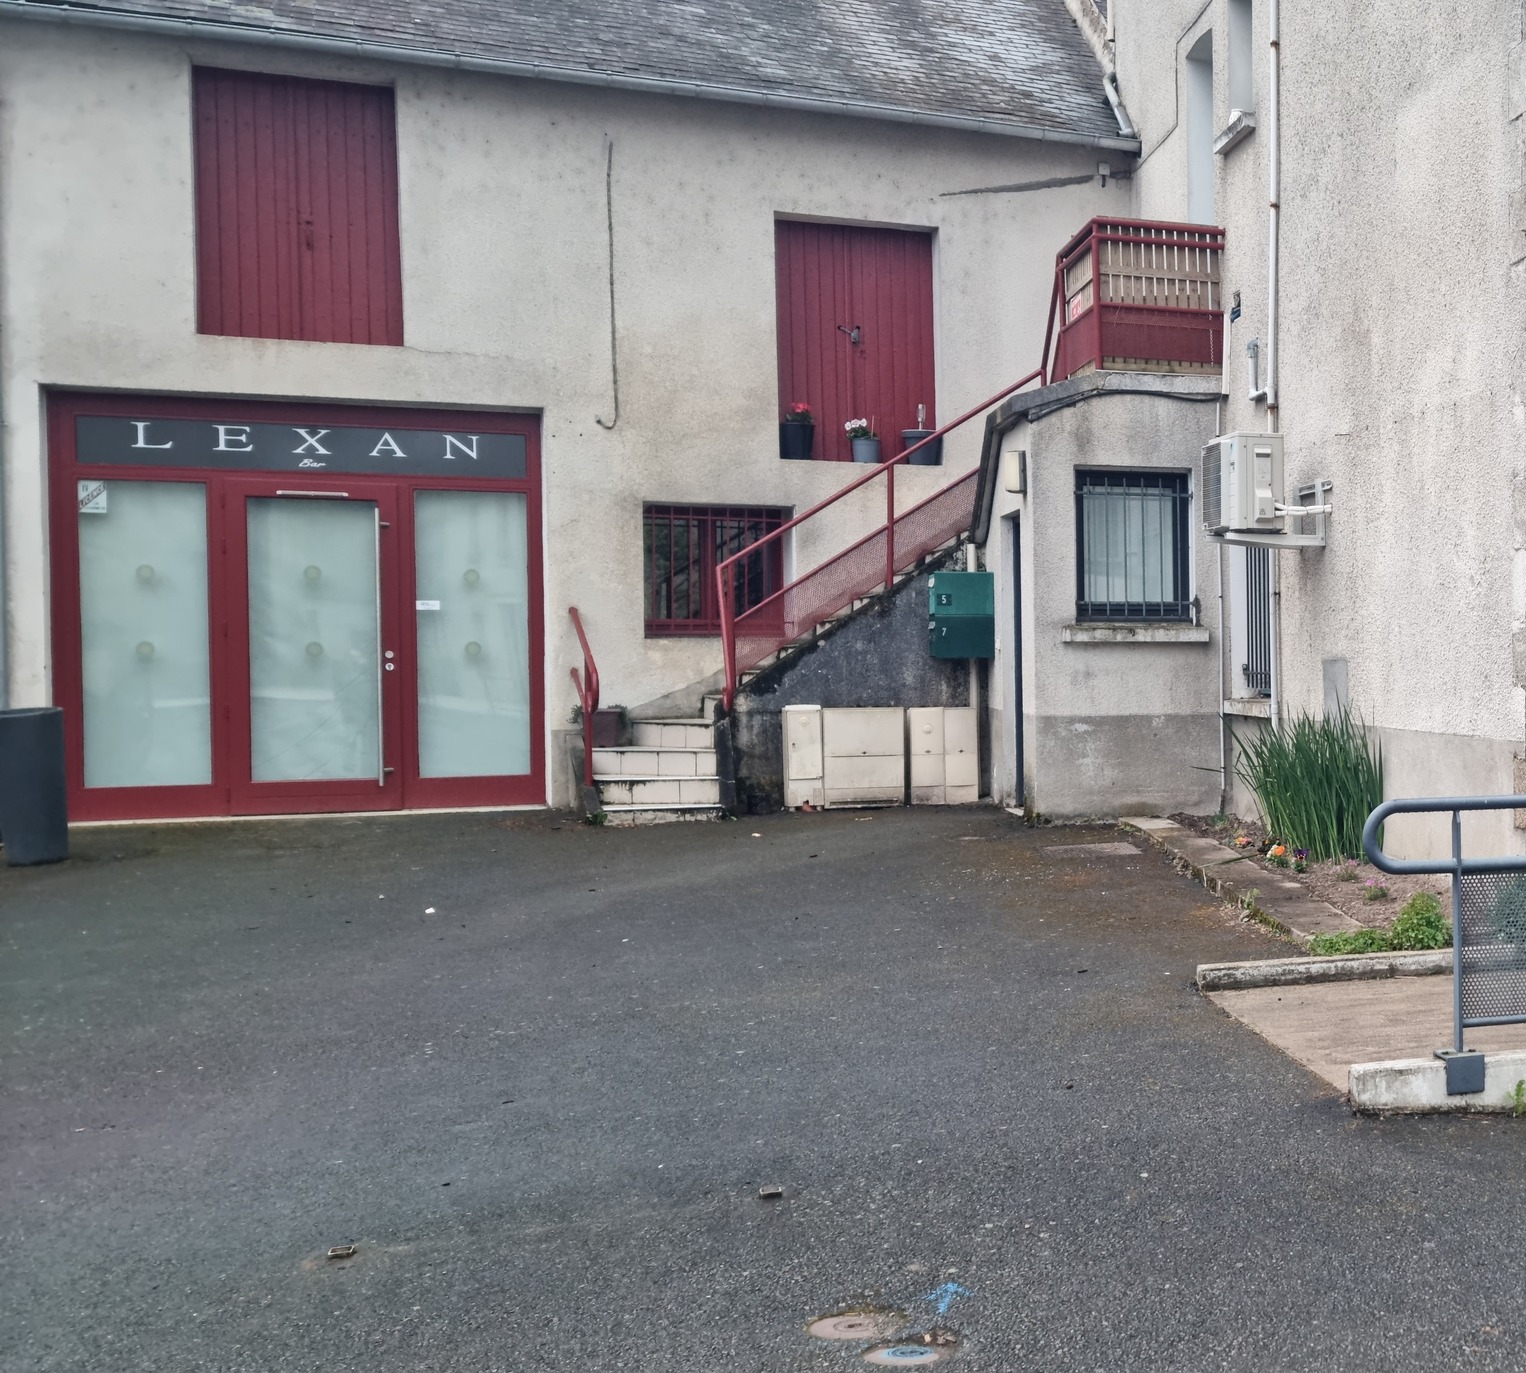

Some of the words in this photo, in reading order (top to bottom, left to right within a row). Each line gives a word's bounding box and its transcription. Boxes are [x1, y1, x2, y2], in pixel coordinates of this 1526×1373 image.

[130, 421, 480, 461] LEXAN
[299, 458, 327, 468] Bar
[941, 595, 947, 604] 5
[941, 627, 947, 637] 7
